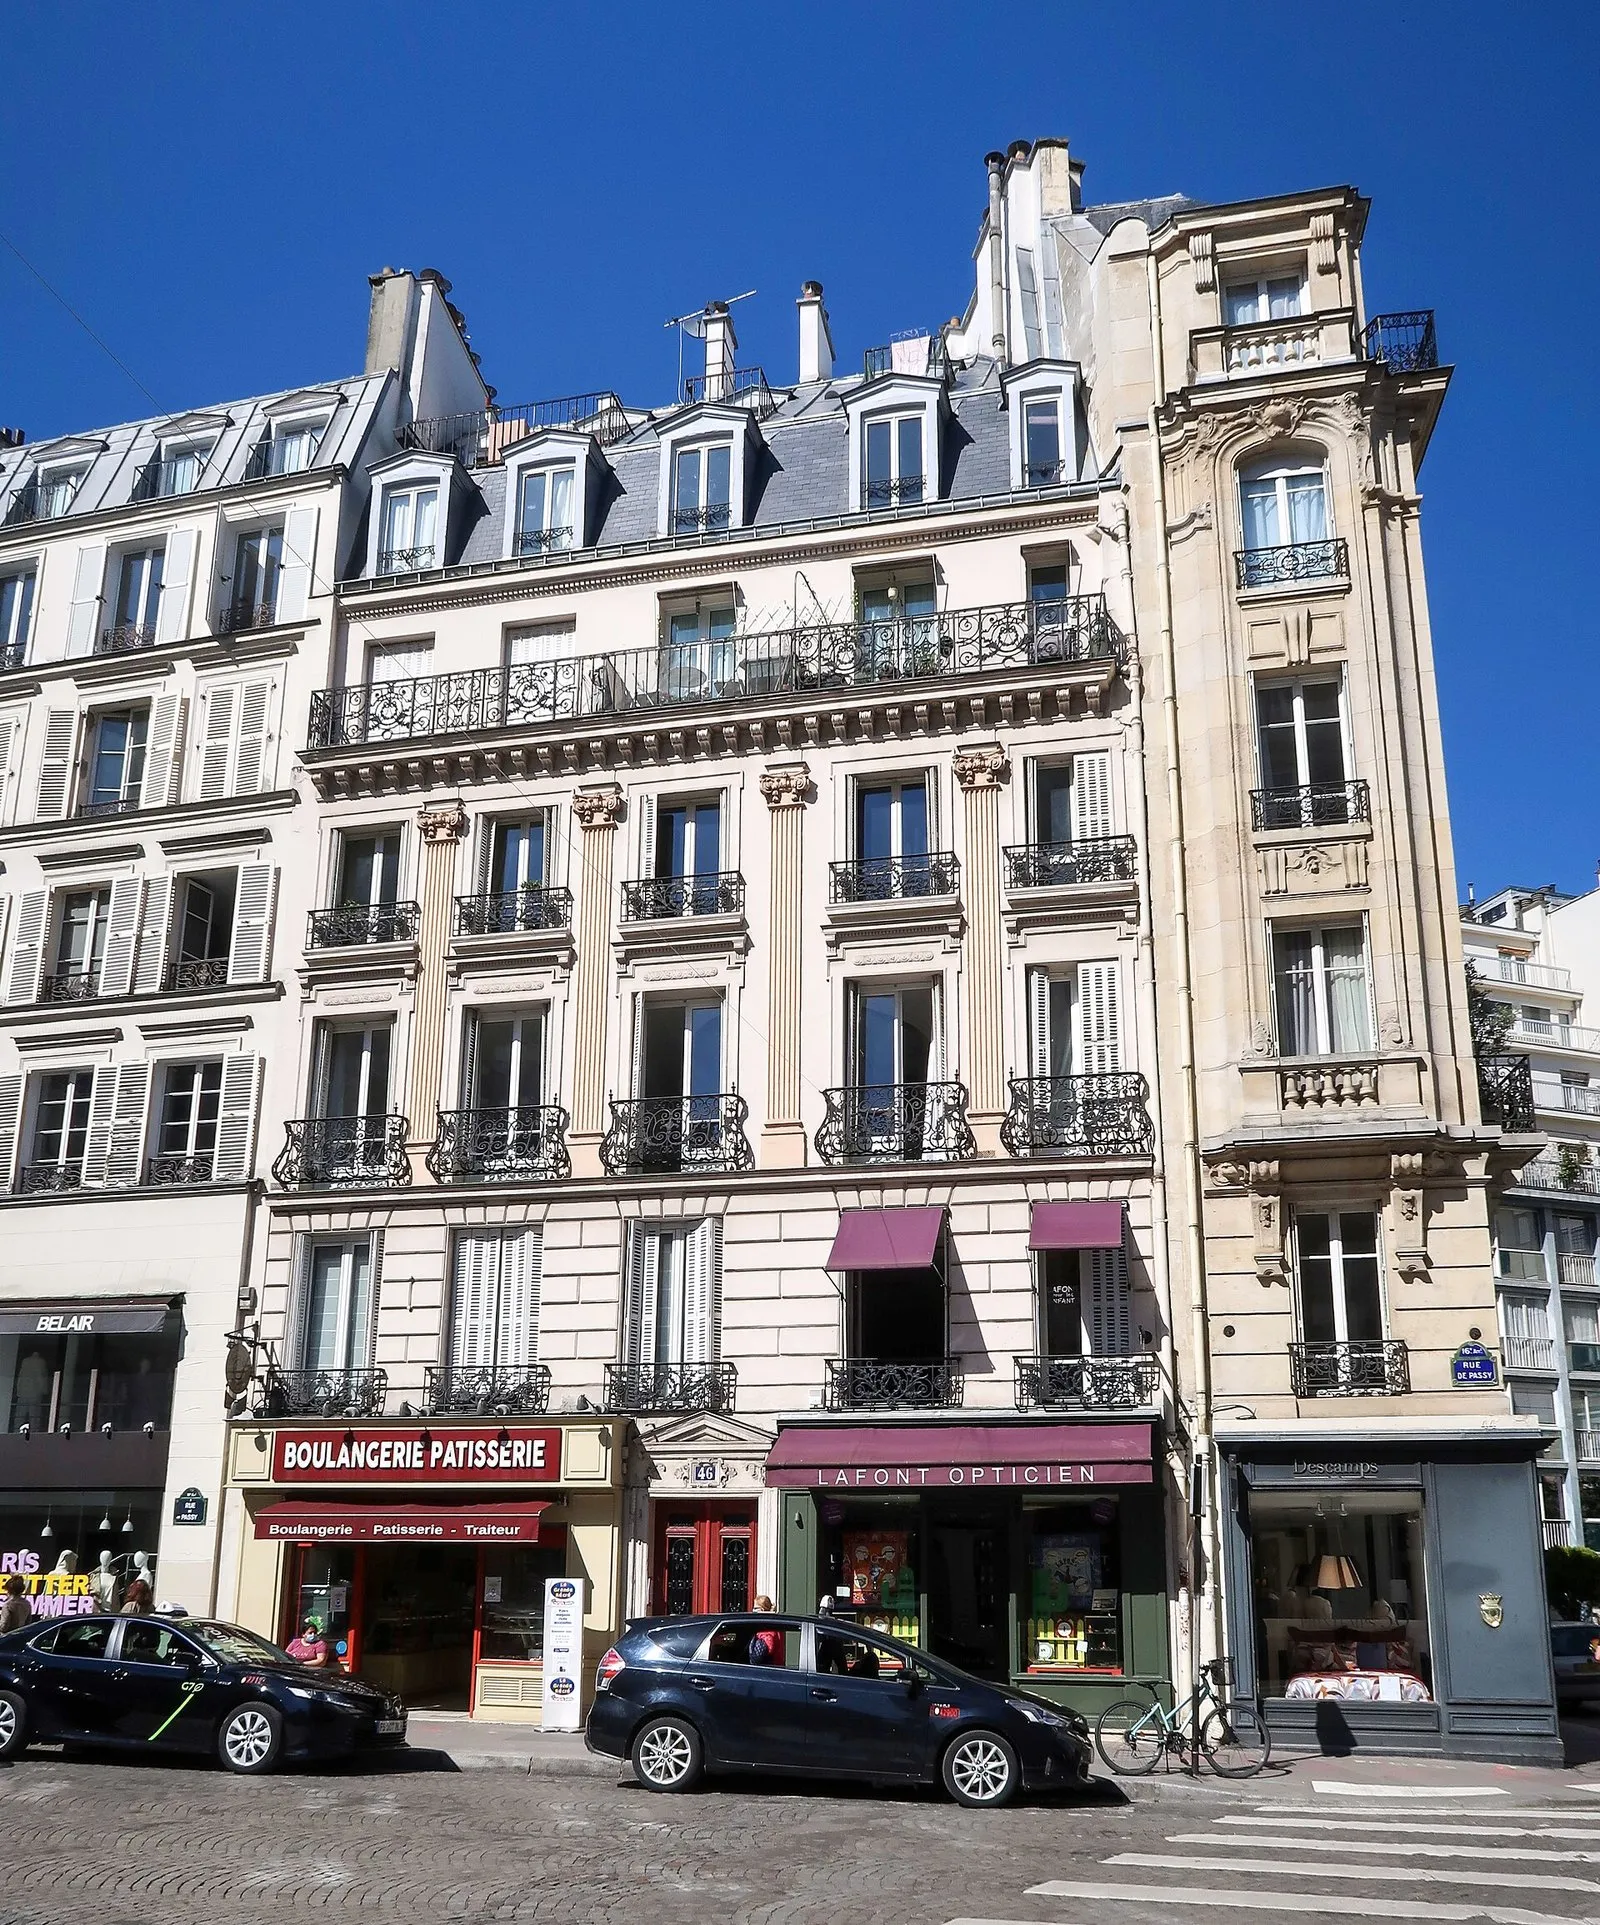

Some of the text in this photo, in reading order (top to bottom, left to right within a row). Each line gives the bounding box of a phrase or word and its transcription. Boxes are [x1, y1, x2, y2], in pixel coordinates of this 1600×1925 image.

[36, 1315, 94, 1332] BELAIR
[1462, 1361, 1481, 1369] RUE
[1457, 1371, 1492, 1380] DE PASSY
[283, 1439, 546, 1469] BOULANGERIE PATISSERIE
[697, 1466, 713, 1480] 46
[818, 1465, 1095, 1485] LAFONT OPTICIEN
[1294, 1459, 1379, 1478] Descamps
[269, 1524, 353, 1536] Boulangerie
[373, 1523, 443, 1535] Patisserie
[464, 1523, 520, 1535] Traiteur
[0, 1574, 89, 1595] BTTER
